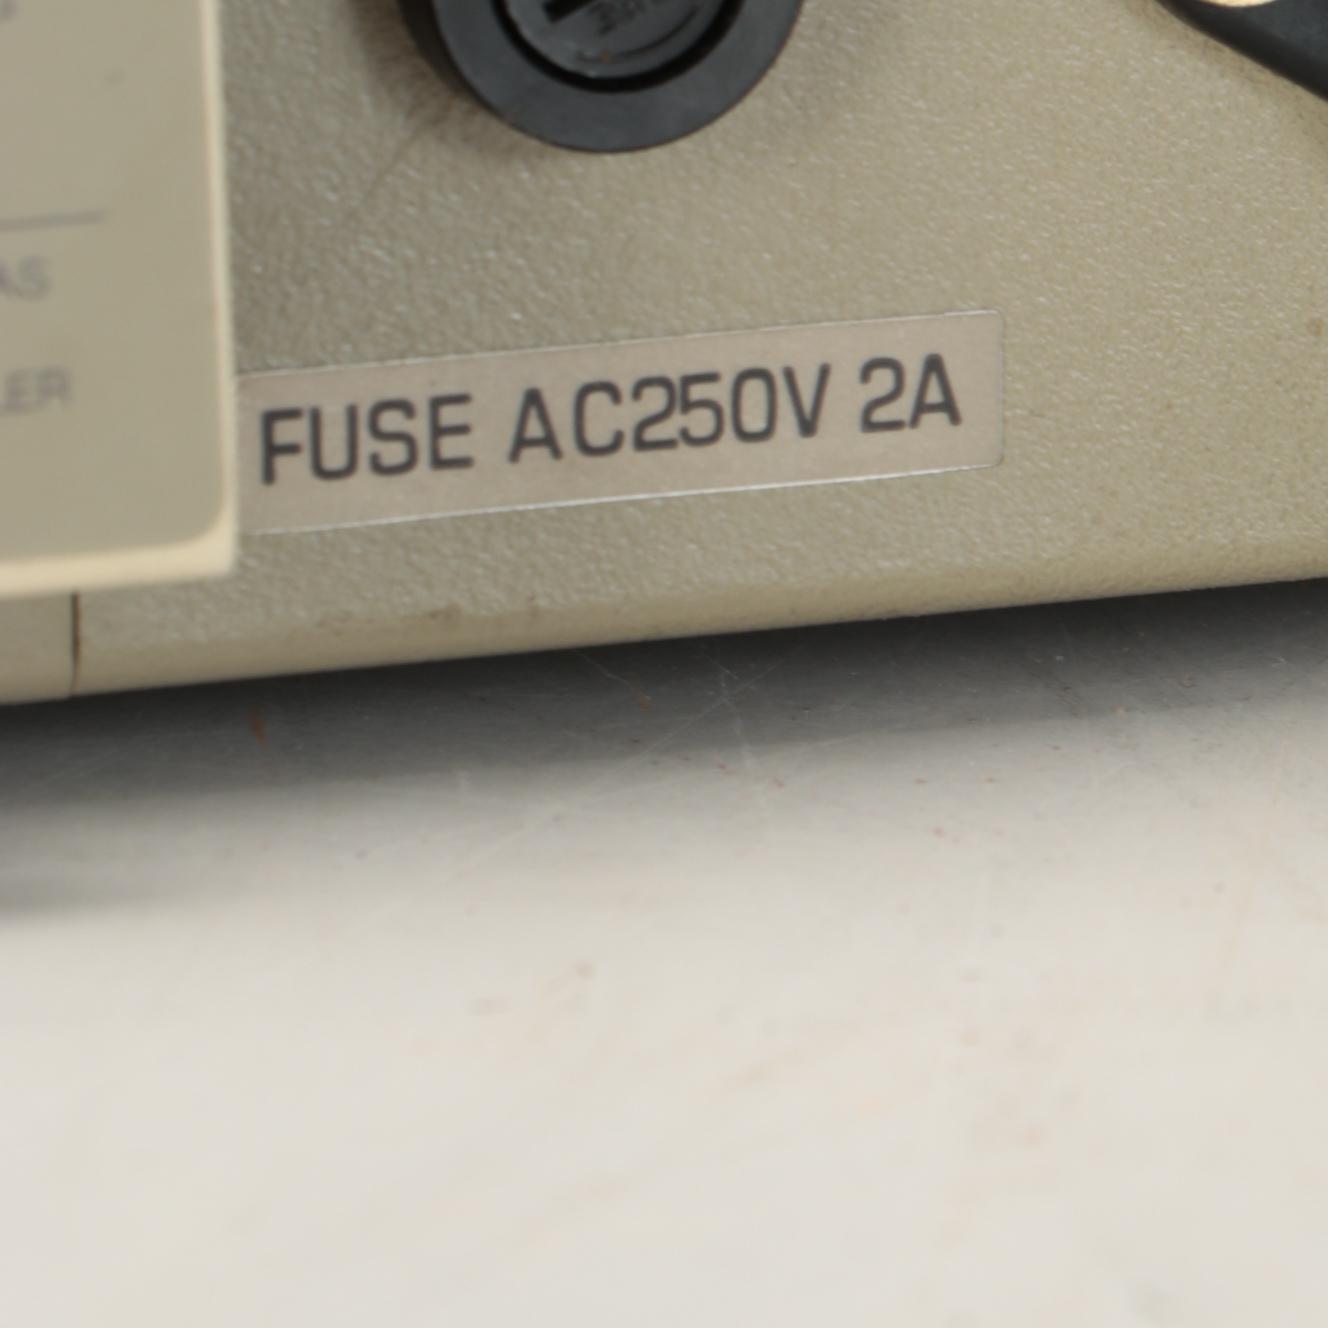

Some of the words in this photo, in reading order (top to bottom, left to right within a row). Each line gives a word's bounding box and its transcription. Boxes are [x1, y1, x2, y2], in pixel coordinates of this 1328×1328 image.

[261, 393, 474, 486] FUSE
[508, 363, 831, 464] AC250V
[858, 353, 963, 430] 2A
